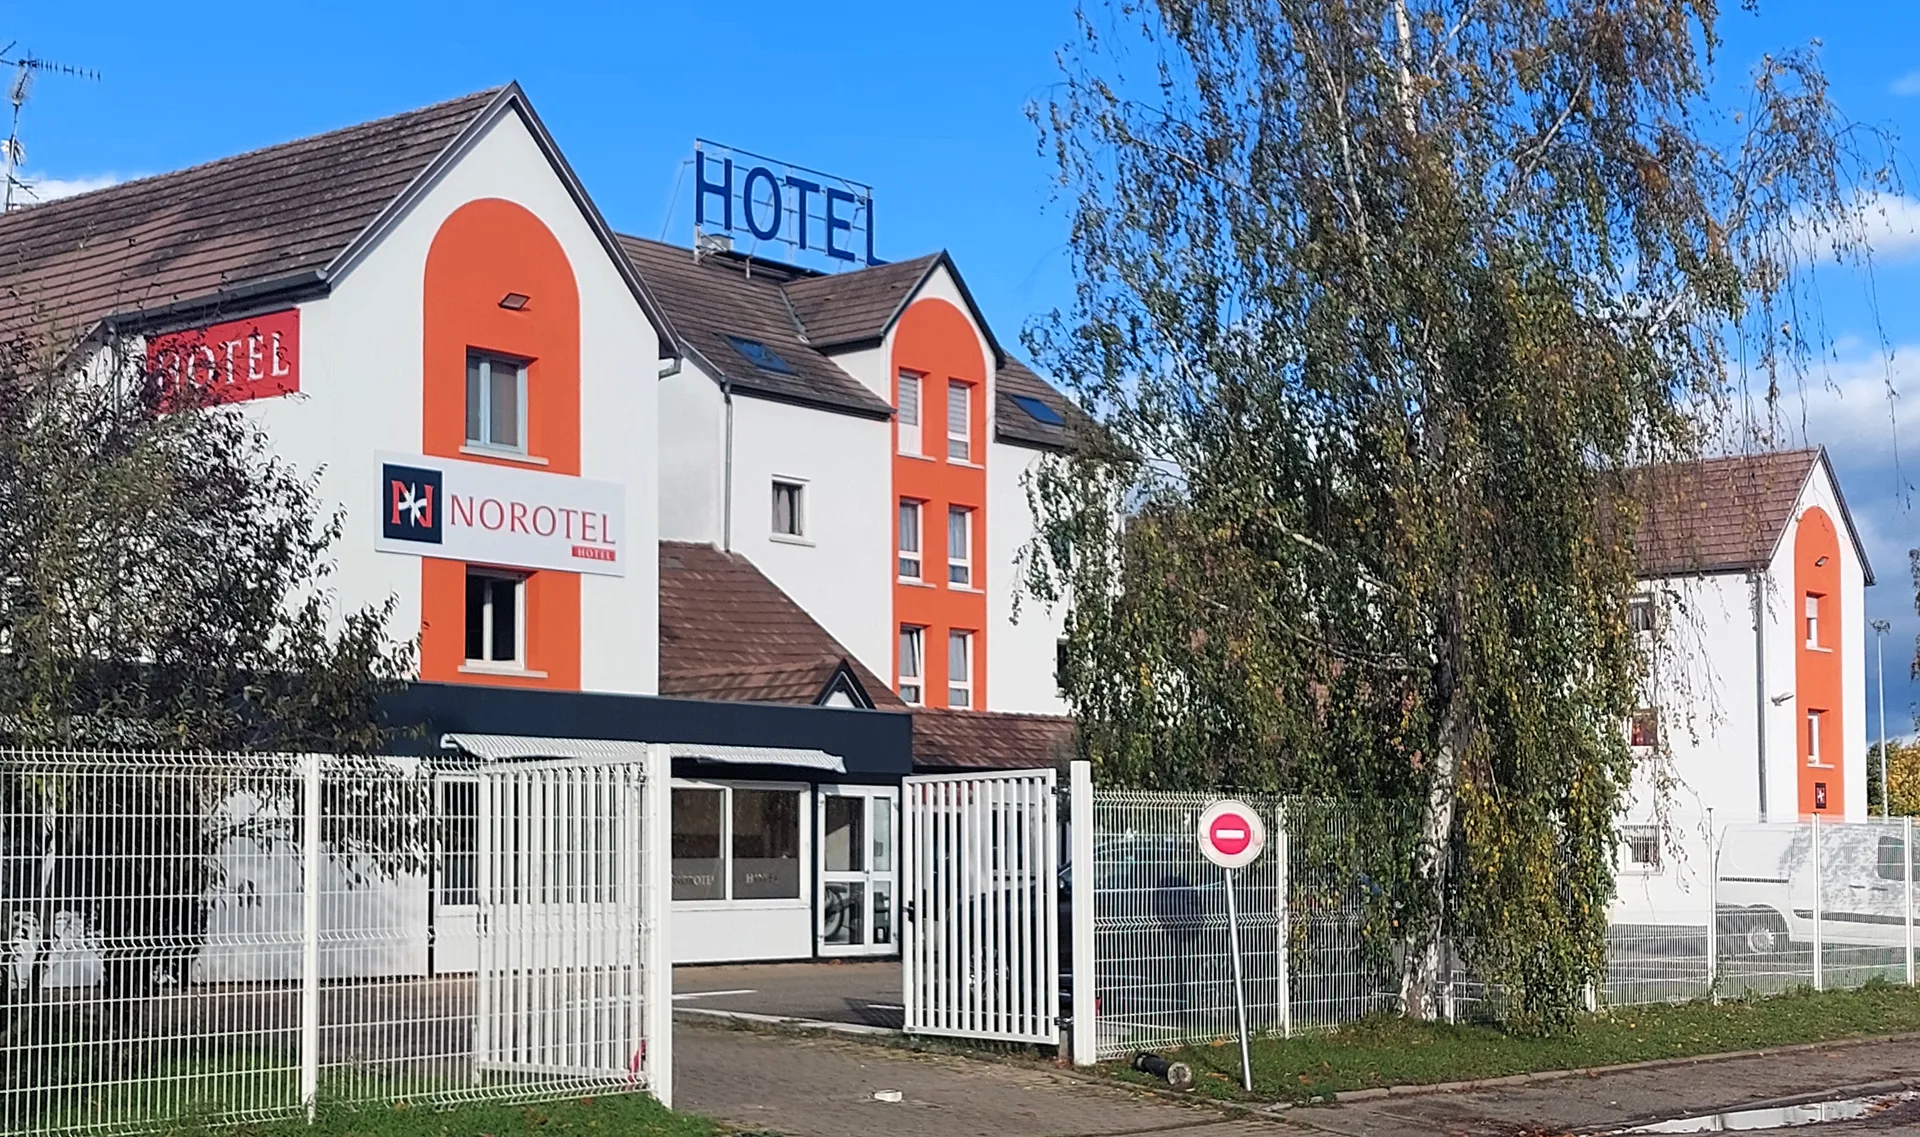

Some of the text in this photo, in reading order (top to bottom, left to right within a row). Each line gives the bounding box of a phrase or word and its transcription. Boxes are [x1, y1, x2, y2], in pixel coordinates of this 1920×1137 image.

[696, 150, 890, 266] HOTEL
[450, 494, 616, 544] NOROTEL
[577, 547, 613, 560] HOTEL
